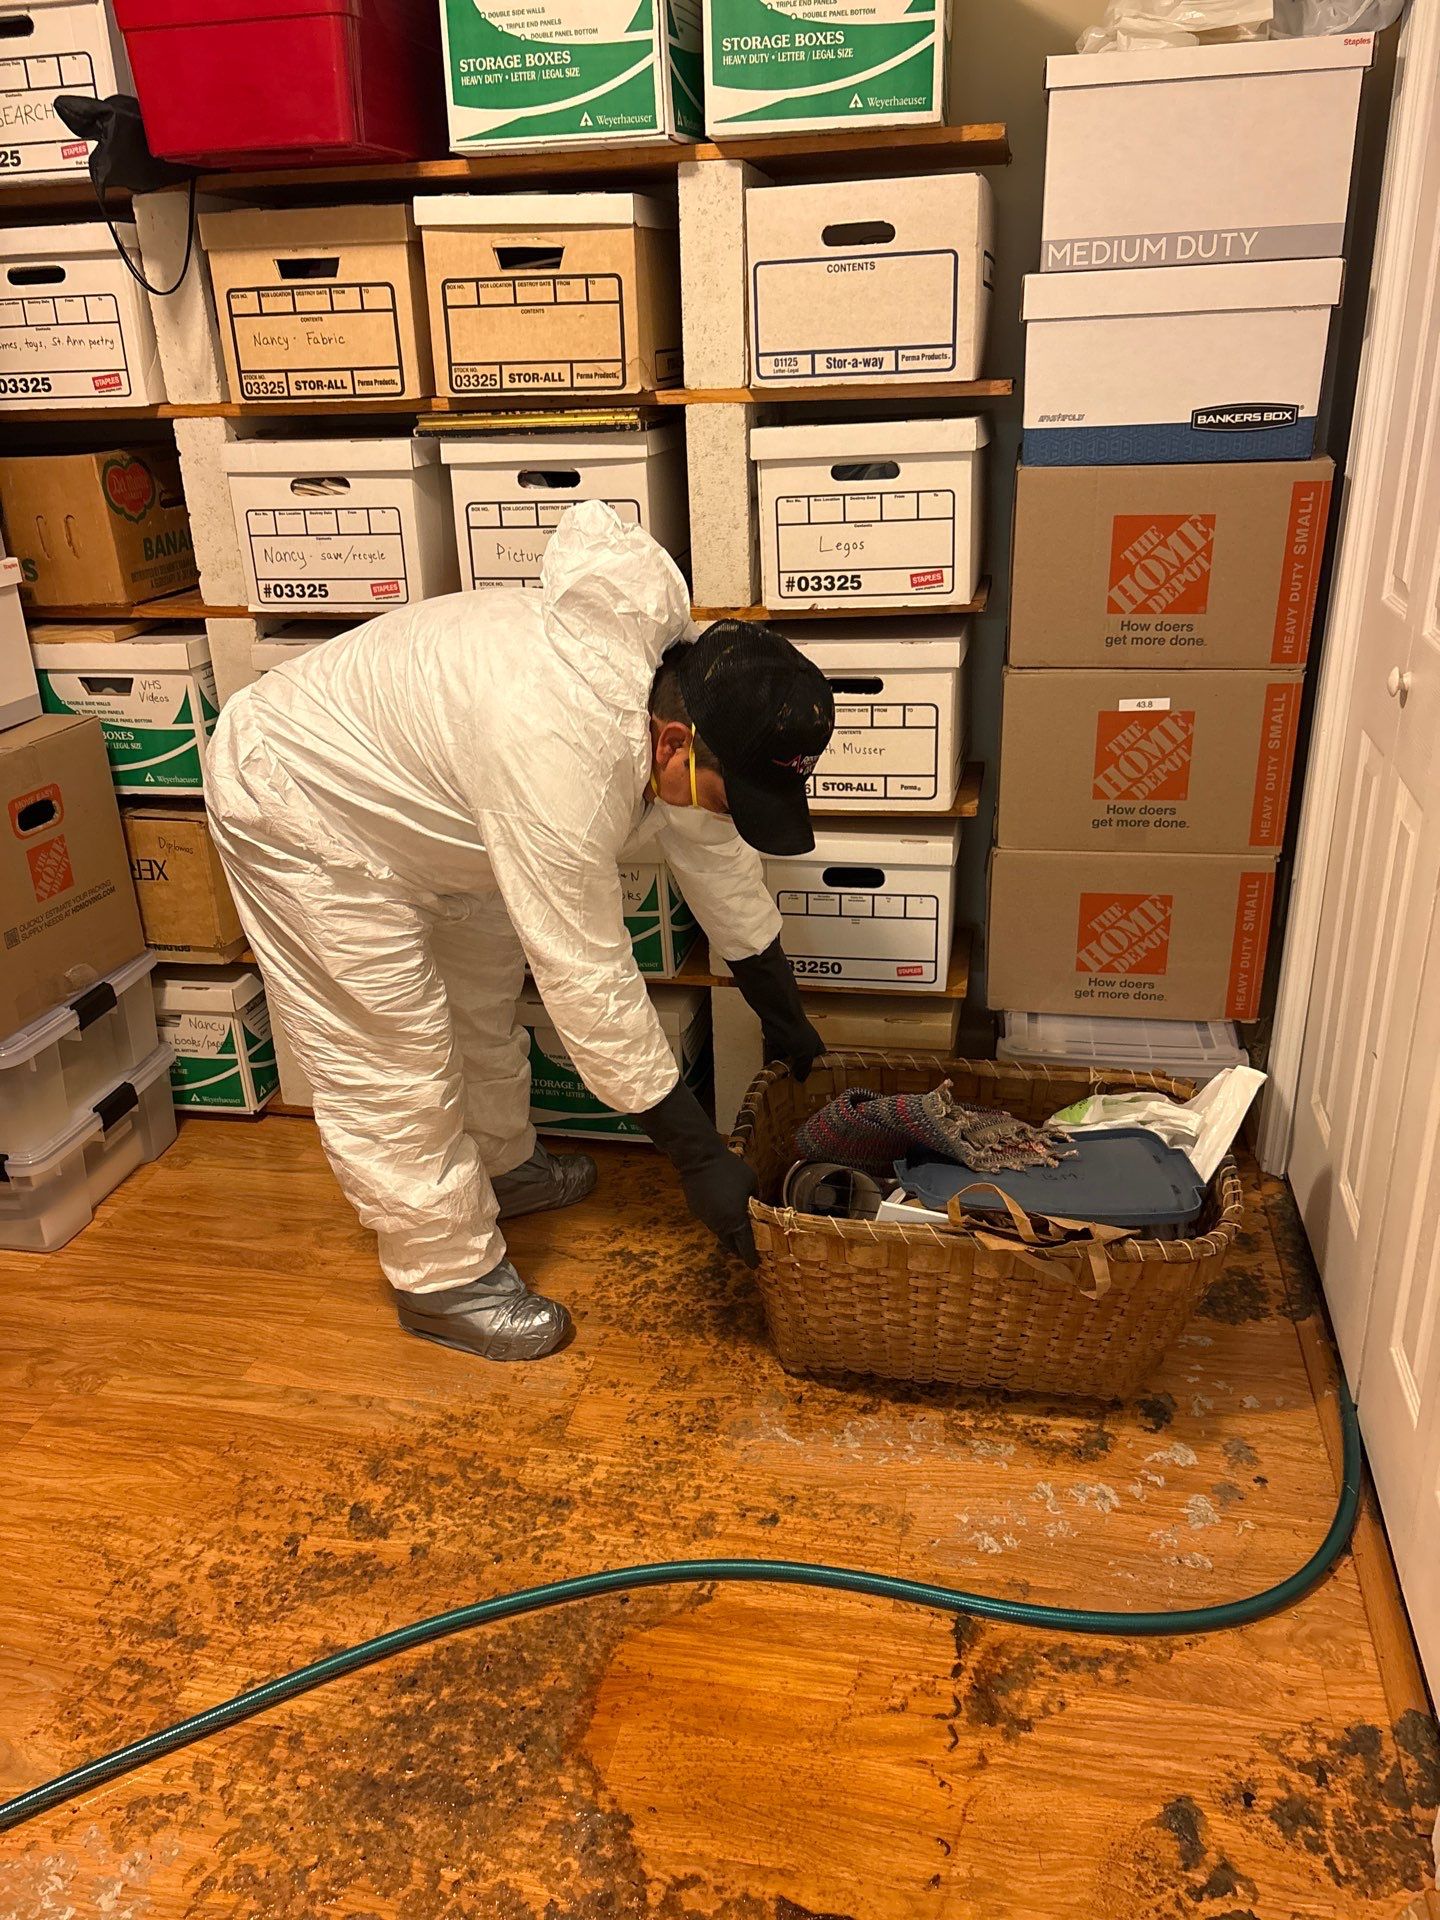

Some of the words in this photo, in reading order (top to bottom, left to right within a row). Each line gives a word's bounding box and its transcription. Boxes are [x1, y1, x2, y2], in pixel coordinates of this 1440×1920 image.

[488, 11, 510, 19] DOUBLE
[527, 7, 545, 15] WALLS
[802, 11, 827, 19] DOUBLE
[850, 8, 876, 16] BOTTOM
[506, 21, 525, 29] TRIPLE
[526, 20, 539, 28] END
[540, 19, 561, 27] PANELS
[530, 31, 553, 39] DOUBLE
[555, 30, 573, 38] PANEL
[574, 28, 598, 36] BOTTOM
[722, 35, 790, 51] STORAGE
[795, 31, 845, 47] BOXES
[1344, 37, 1371, 46] Staples
[459, 54, 522, 72] STORAGE
[526, 51, 571, 67] BOXES
[723, 55, 747, 66] HEAVY
[749, 53, 769, 64] DUTY
[778, 51, 805, 62] LETTER
[812, 49, 836, 61] LEGAL
[837, 48, 854, 59] SIZE
[461, 75, 483, 86] HEAVY
[485, 73, 503, 84] DUTY
[511, 70, 536, 82] LETTER
[542, 68, 564, 80] LEGAL
[565, 67, 580, 78] SIZE
[867, 96, 926, 109] Weyerhaeuser
[596, 114, 653, 128] Weyerhaeuser
[1047, 237, 1167, 269] MEDIUM
[1176, 231, 1259, 260] DUTY
[826, 261, 876, 273] CONTENTS
[67, 336, 86, 346] Ann
[89, 337, 114, 350] poetry
[254, 332, 289, 350] Nancy
[306, 331, 346, 345] Fabric
[774, 358, 798, 368] 01125
[825, 357, 884, 371] Stor-a-way
[901, 353, 920, 363] Perma
[95, 376, 120, 387] STAPLES
[245, 381, 285, 395] 03325
[455, 373, 497, 388] 03325
[577, 372, 594, 380] Perma
[1197, 413, 1261, 424] BANKERS
[1263, 411, 1292, 421] BOX
[1294, 492, 1312, 555] SMALL
[819, 536, 865, 558] Legos
[1120, 525, 1164, 565] THE
[264, 547, 307, 570] Nancy
[321, 545, 386, 564] save/recycle
[1108, 515, 1215, 614] HOME
[785, 575, 862, 592] #03325
[912, 573, 942, 585] STAPLES
[1145, 552, 1212, 614] DEPOT
[1289, 563, 1304, 602] DUTY
[263, 584, 329, 598] #03325
[373, 584, 398, 593] STAPLES
[1120, 621, 1151, 632] How
[1155, 621, 1194, 632] doers
[1282, 607, 1298, 654] HEAVY
[1105, 635, 1127, 647] get
[1131, 636, 1166, 646] more
[1169, 635, 1207, 646] done.
[140, 680, 162, 690] VHS
[138, 691, 169, 703] Videos
[1268, 693, 1286, 749] SMALL
[113, 742, 130, 750] LEGAL
[1105, 720, 1146, 756] THE
[843, 743, 886, 756] Musser
[1093, 711, 1194, 799] HOME
[157, 775, 198, 784] Weyerhaeuser
[1130, 745, 1191, 800] DEPOT
[1265, 755, 1279, 791] DUTY
[36, 789, 55, 801] EASY
[822, 782, 877, 792] STOR-ALL
[1106, 805, 1136, 815] How
[1139, 805, 1177, 816] doers
[1260, 796, 1274, 838] HEAVY
[1092, 818, 1113, 829] get
[1116, 819, 1150, 828] more
[1153, 818, 1190, 829] done.
[158, 837, 194, 854] Diplomas
[34, 850, 49, 873] THE
[36, 836, 68, 900] HOME
[51, 857, 71, 894] DEPOT
[19, 913, 44, 933] QUICKLY
[45, 901, 72, 919] ESTIMATE
[72, 892, 87, 908] YOUR
[88, 879, 112, 900] PACKING
[1243, 880, 1260, 931] SMALL
[20, 924, 44, 943] SUPPLY
[44, 917, 64, 931] NEEDS
[64, 910, 71, 919] AT
[72, 887, 116, 917] HDMOVING.COM
[1087, 902, 1127, 934] THE
[1076, 895, 1172, 973] HOME
[1111, 926, 1170, 973] DEPOT
[1240, 933, 1254, 968] DUTY
[898, 967, 922, 975] STAPLES
[1088, 977, 1116, 987] How
[1119, 979, 1155, 989] doers
[1075, 989, 1094, 999] get
[1098, 991, 1129, 1000] more
[1133, 991, 1167, 1001] done.
[1234, 973, 1248, 1011] HEAVY
[189, 1017, 225, 1036] Nancy
[531, 1079, 574, 1089] TORAGE
[202, 1096, 240, 1104] Weyerhaeuser
